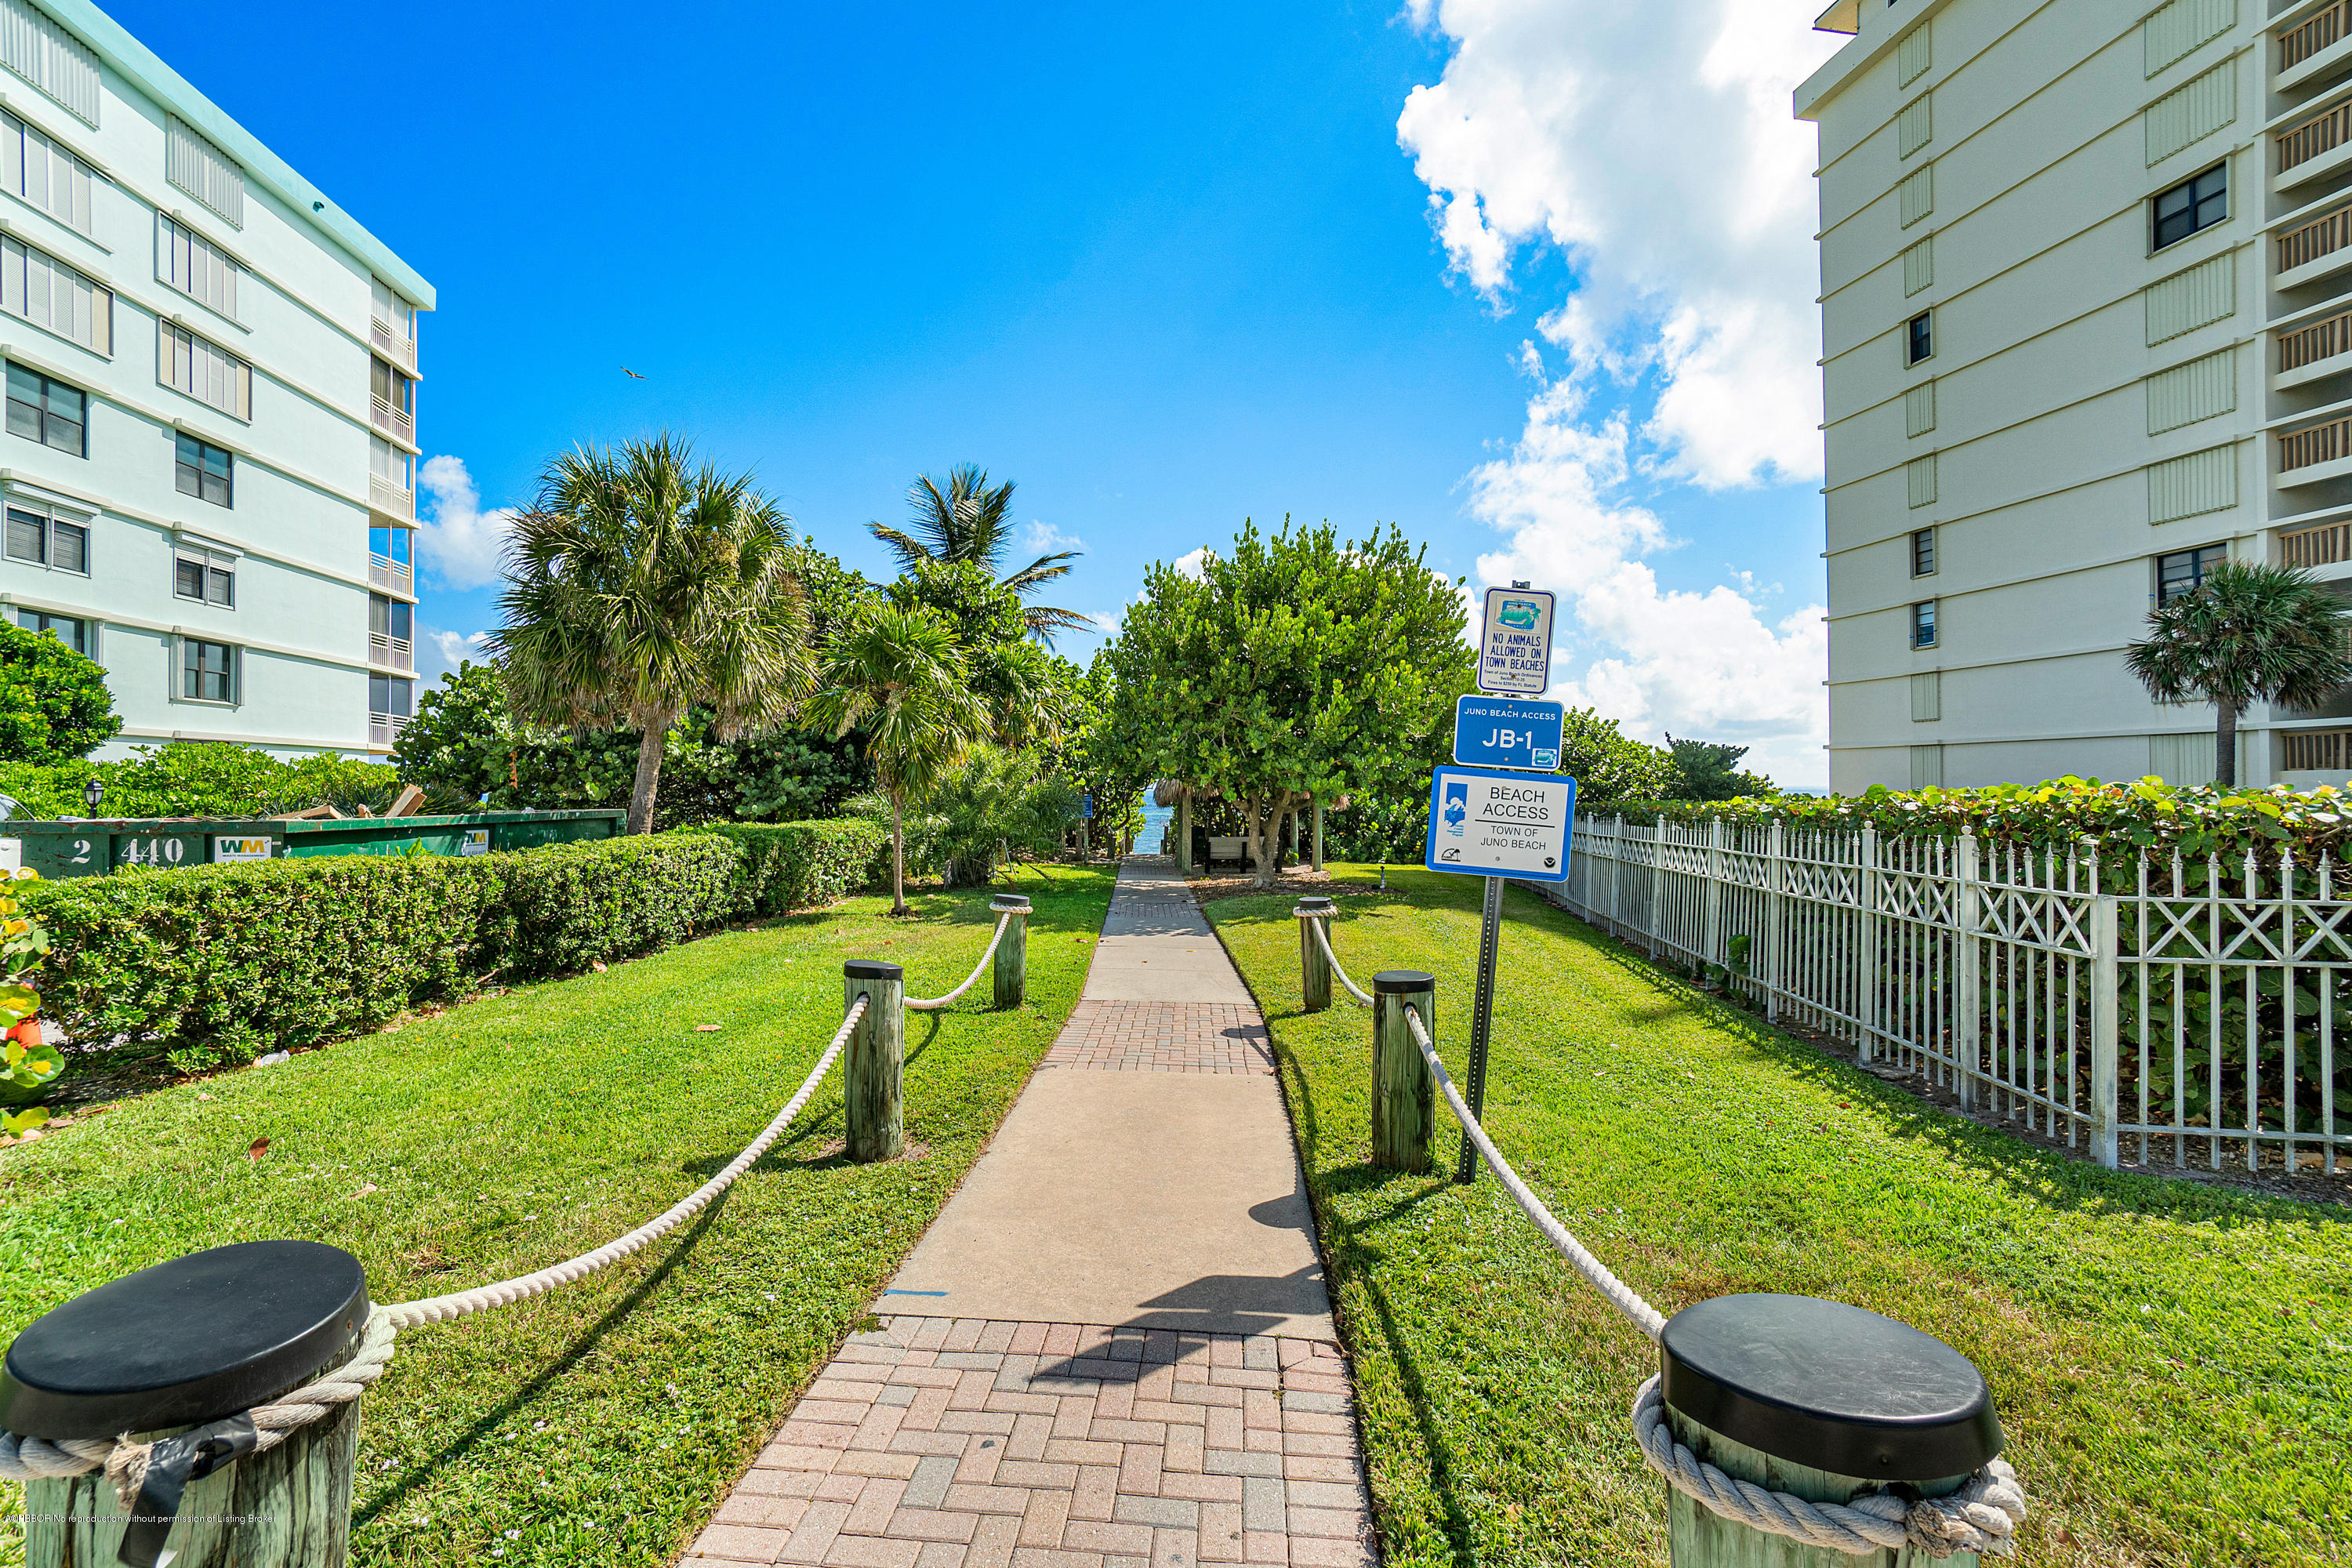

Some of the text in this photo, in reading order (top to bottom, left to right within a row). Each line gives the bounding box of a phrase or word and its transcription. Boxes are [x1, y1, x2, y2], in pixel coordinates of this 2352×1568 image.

[1493, 633, 1541, 647] NO ANIMALS
[1490, 645, 1541, 659] ALLOWED ON
[1486, 656, 1544, 671] TOWN BEACHES
[1490, 710, 1519, 718] BEACH
[1521, 712, 1555, 720] ACCESS
[1482, 728, 1532, 750] JB-1
[1490, 786, 1544, 804] BEACH
[1483, 803, 1548, 820] ACCESS
[1491, 826, 1538, 837] TOWN OF
[71, 838, 183, 864] 2 440
[220, 840, 265, 853] WM
[1480, 837, 1546, 851] JUNO BEACH
